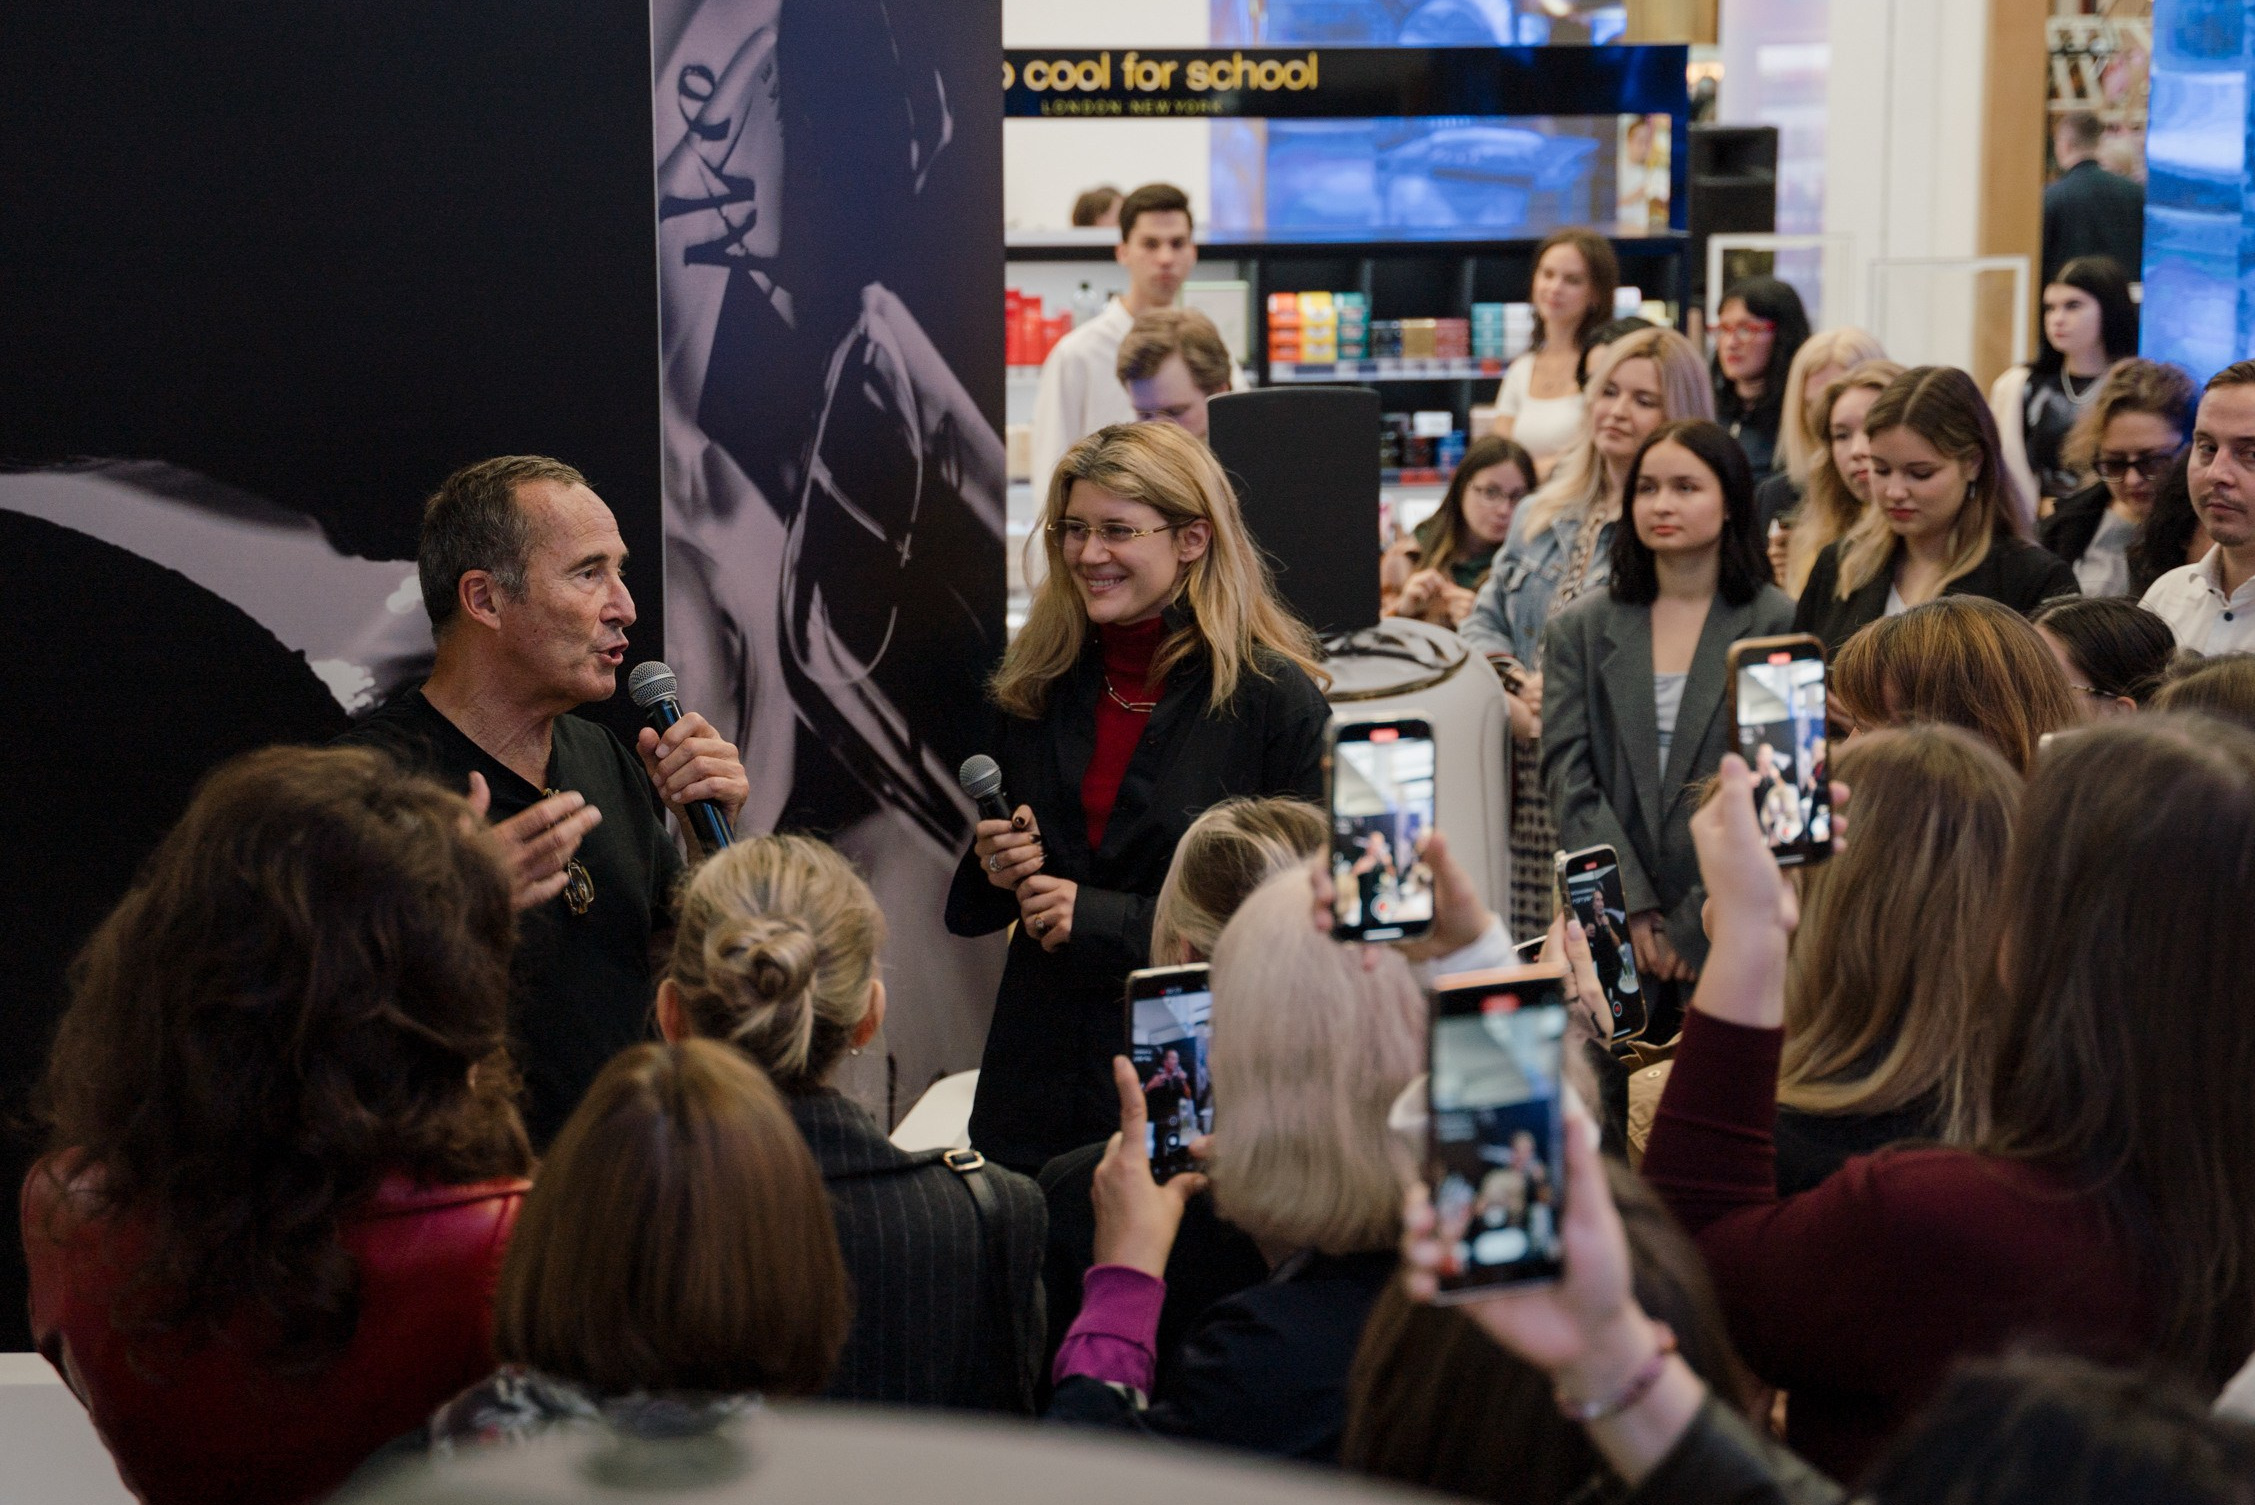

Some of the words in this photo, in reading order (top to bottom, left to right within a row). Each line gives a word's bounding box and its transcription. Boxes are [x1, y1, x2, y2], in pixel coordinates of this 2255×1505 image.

[1023, 51, 1111, 92] cool
[1121, 51, 1178, 92] for
[1186, 51, 1318, 92] school
[1040, 99, 1122, 115] LONDON
[1129, 99, 1171, 115] NEW
